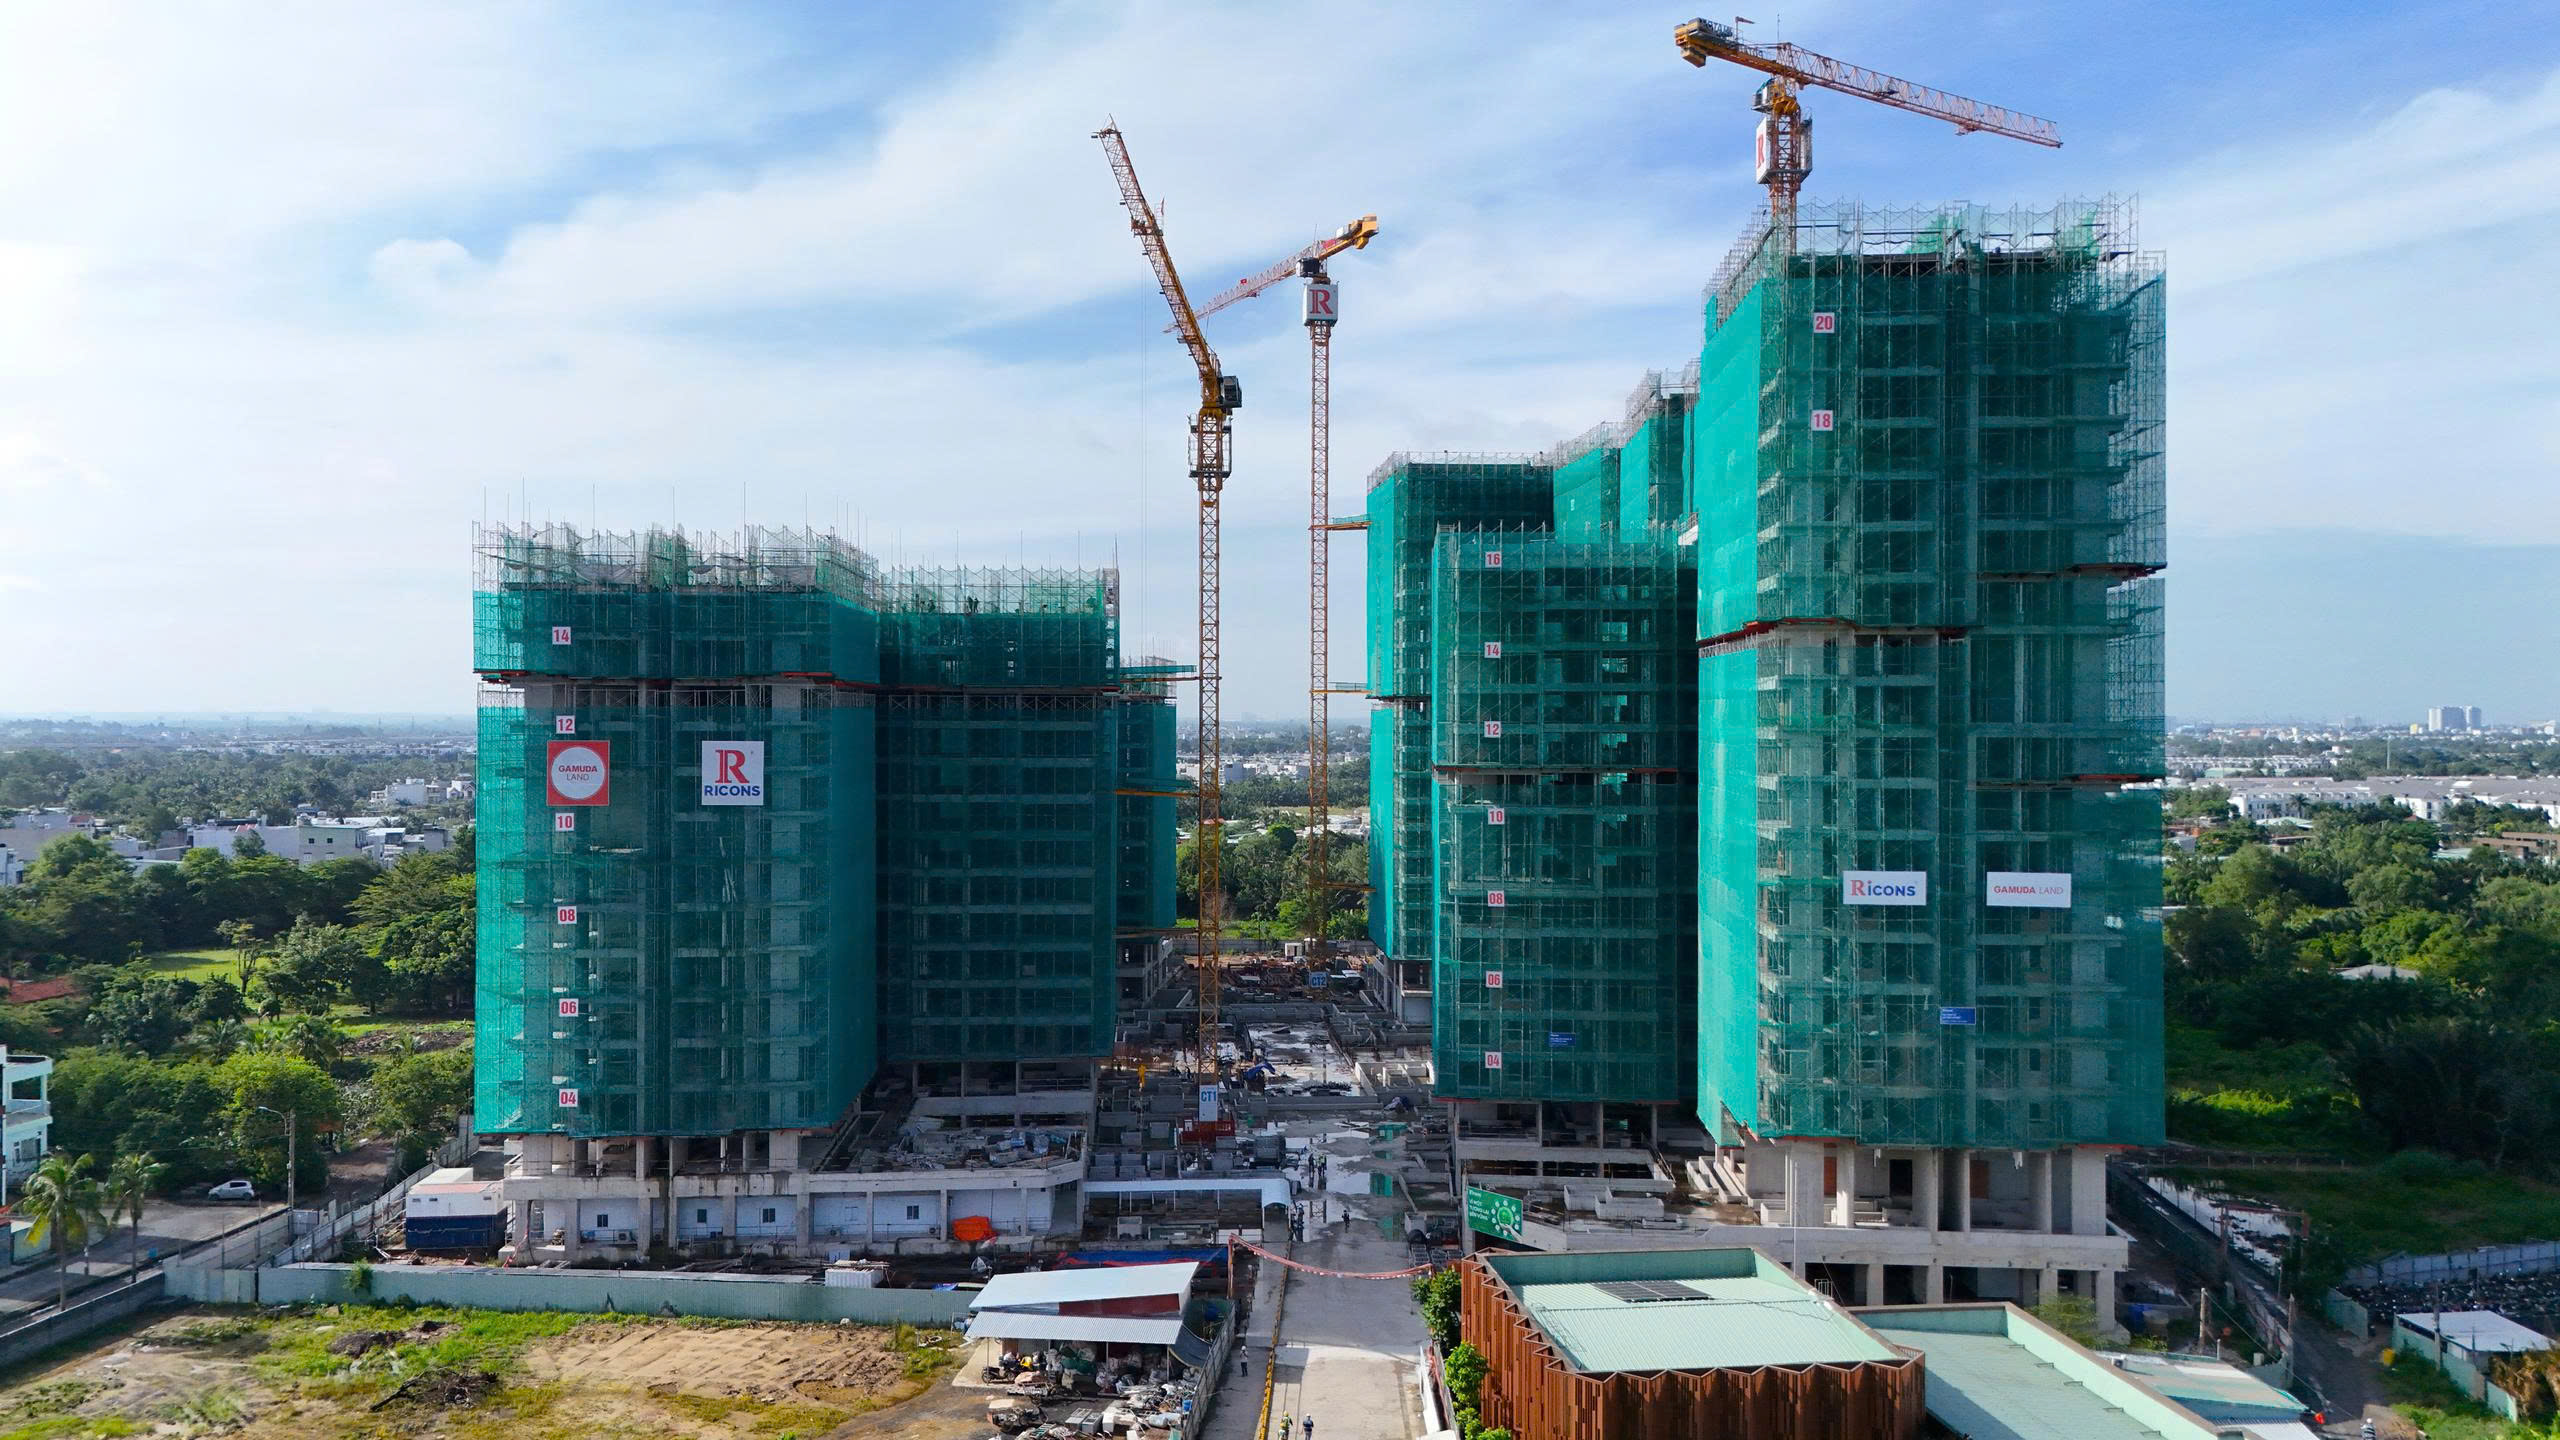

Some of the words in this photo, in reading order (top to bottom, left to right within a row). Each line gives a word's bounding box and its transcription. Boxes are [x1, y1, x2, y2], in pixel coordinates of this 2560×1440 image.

[1309, 288, 1333, 315] R
[1815, 315, 1833, 331] 20
[1814, 413, 1831, 428] 18
[1486, 553, 1501, 566] 16
[553, 629, 569, 642] 14
[1486, 644, 1500, 657] 14
[557, 718, 573, 732] 12
[1486, 723, 1499, 736] 12
[558, 764, 598, 773] GAMUDA
[714, 749, 750, 784] R
[566, 773, 590, 781] LAND
[704, 785, 761, 797] RICONS
[557, 815, 573, 829] 10
[1489, 810, 1504, 823] 10
[1993, 885, 2036, 894] GAMUDA
[2039, 886, 2064, 895] LAND
[1488, 892, 1504, 905] 08
[558, 909, 576, 922] 08
[1487, 973, 1501, 986] 06
[560, 1001, 577, 1015] 06
[1486, 1055, 1500, 1068] 04
[560, 1091, 577, 1105] 04
[1201, 1090, 1217, 1102] CT1
